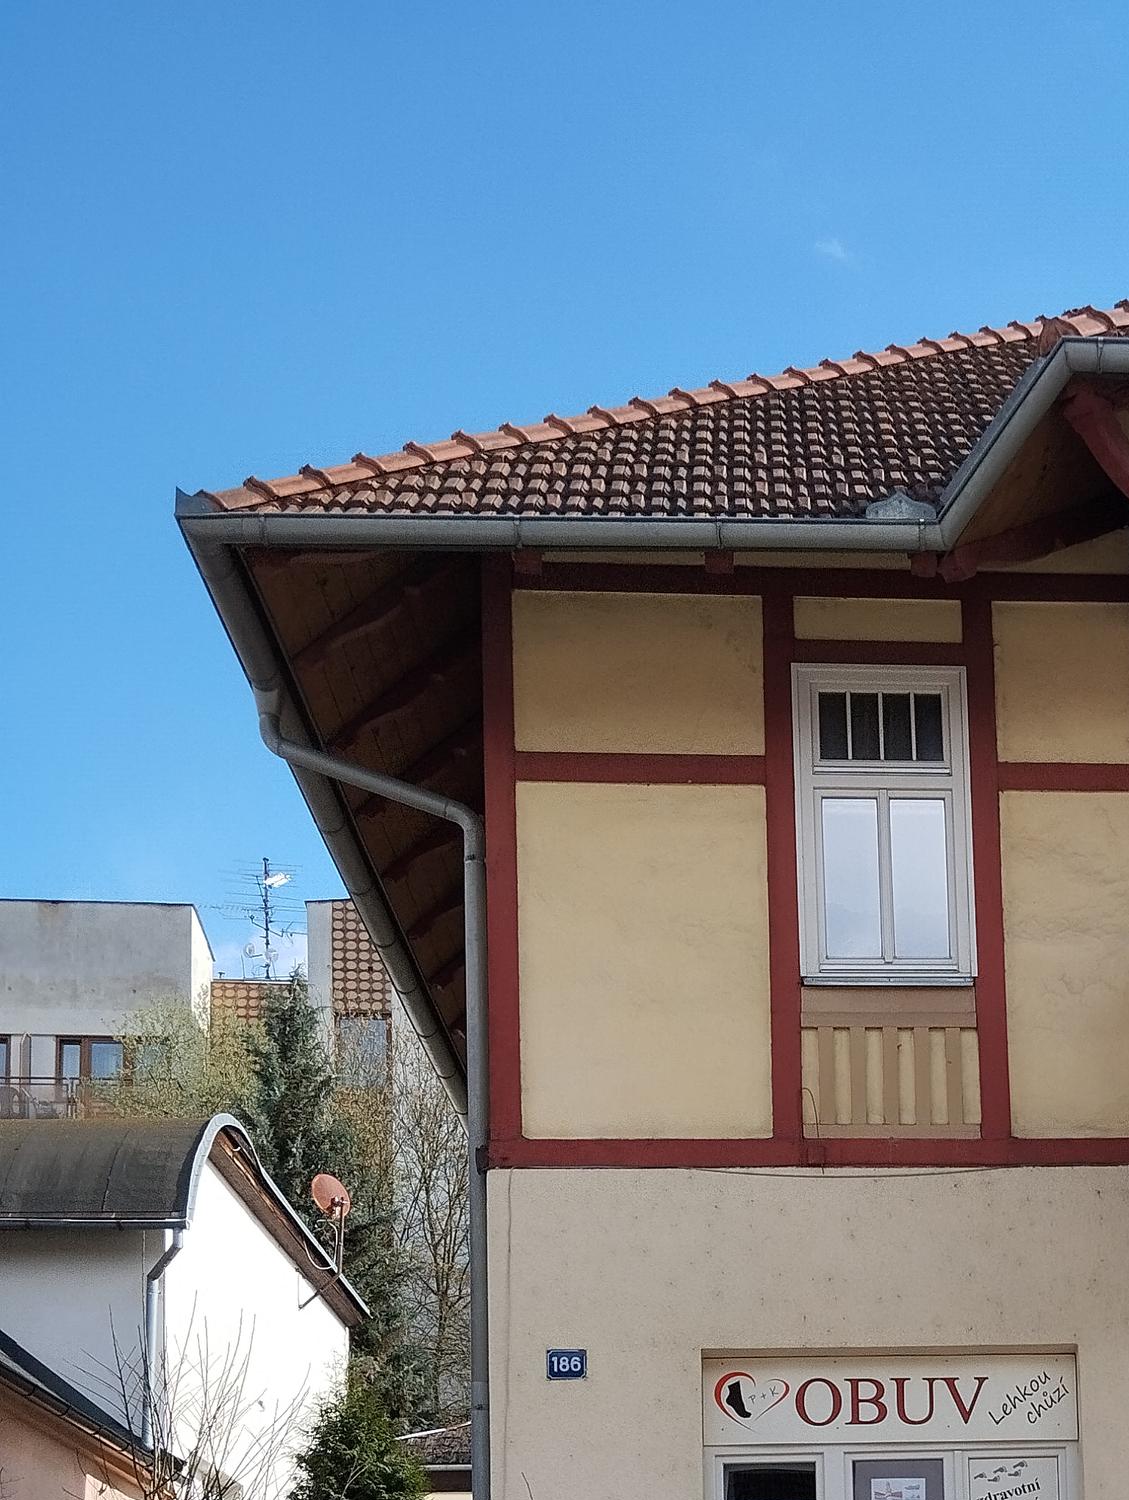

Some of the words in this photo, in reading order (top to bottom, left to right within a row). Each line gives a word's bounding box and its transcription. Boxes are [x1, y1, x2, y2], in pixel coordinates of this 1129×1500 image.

[551, 1356, 581, 1372] 186
[794, 1376, 989, 1427] OBUV
[988, 1371, 1051, 1425] Lehkou
[1027, 1376, 1070, 1424] chůzí
